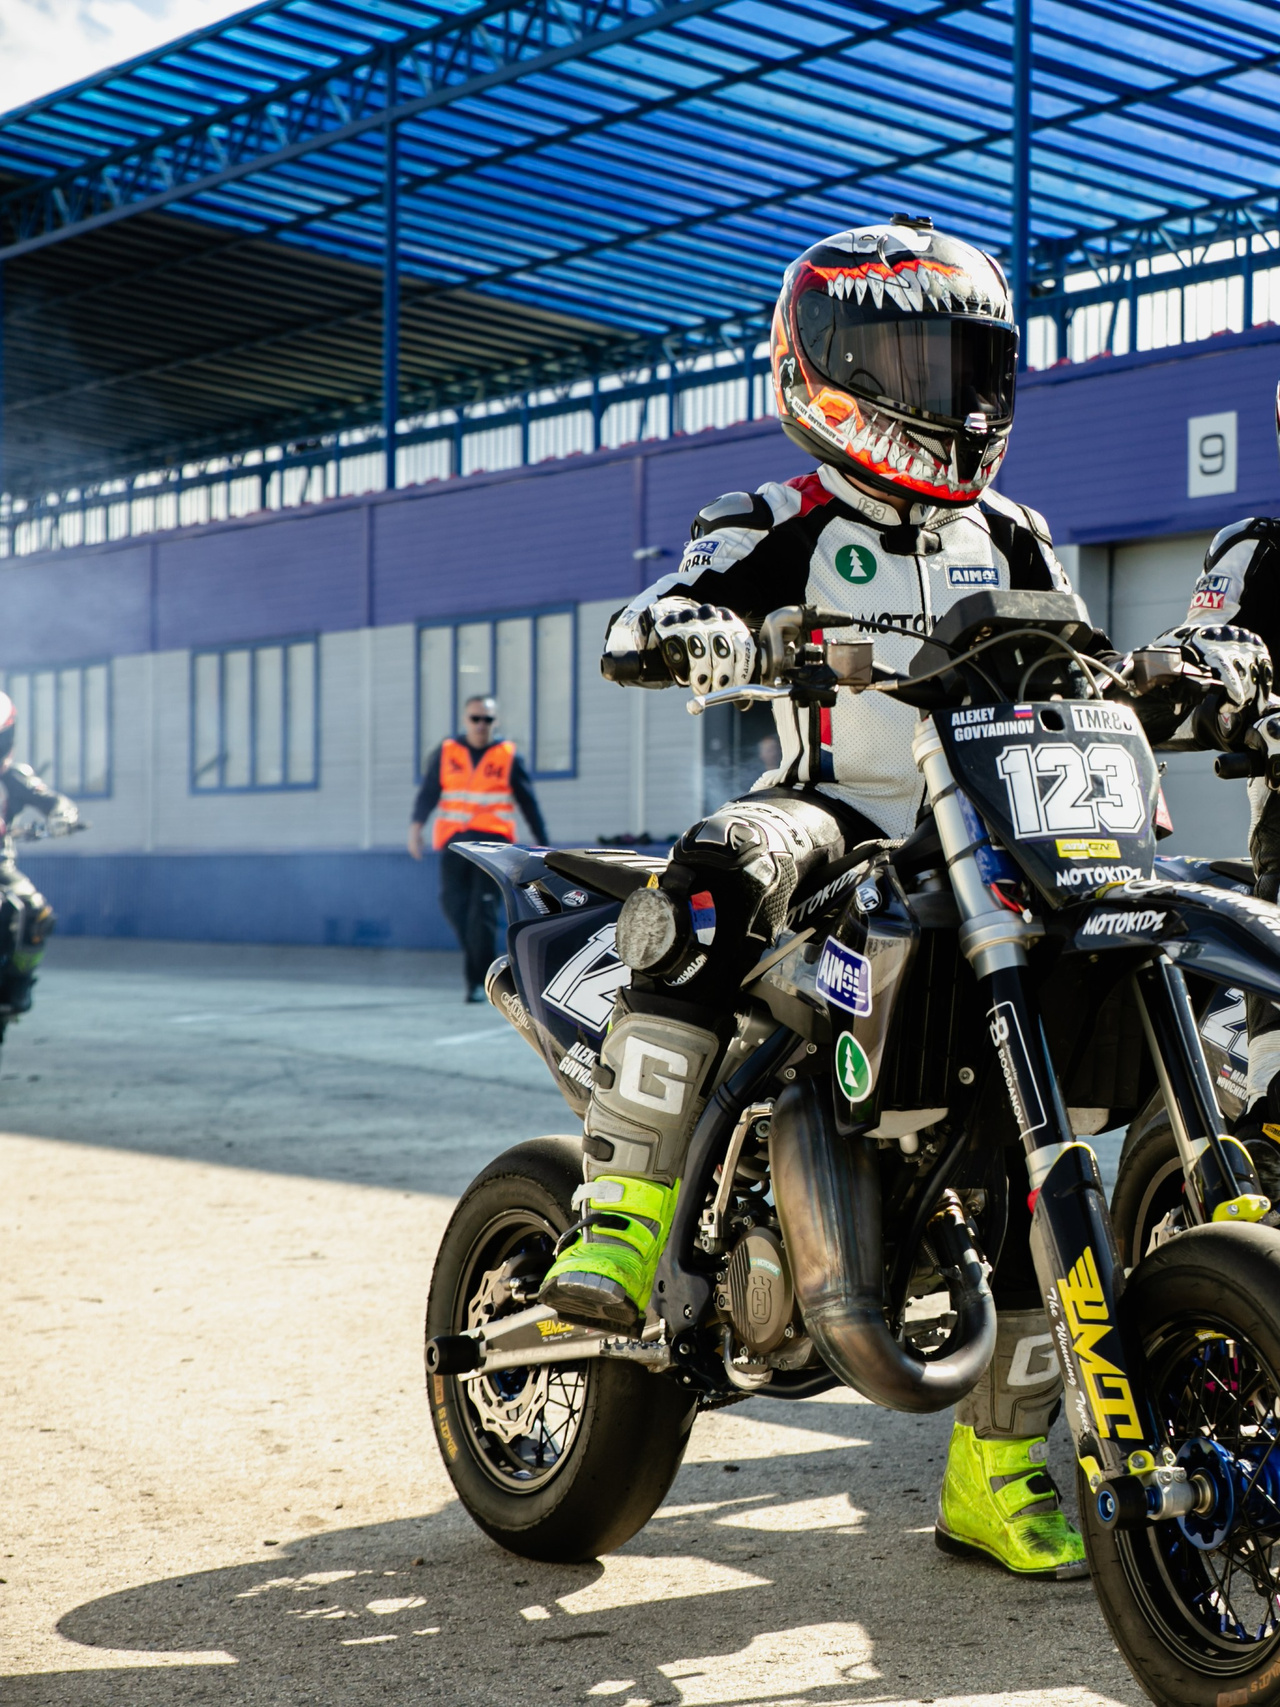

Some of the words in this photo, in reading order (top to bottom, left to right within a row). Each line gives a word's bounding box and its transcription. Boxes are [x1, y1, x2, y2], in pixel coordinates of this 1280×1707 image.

[1199, 433, 1225, 475] 9
[857, 497, 886, 520] 123
[951, 570, 998, 583] AIMOL
[952, 706, 996, 727] ALEXEY
[954, 719, 1035, 743] GOVYADINOV
[995, 742, 1147, 840] 123
[1056, 866, 1145, 888] MOTOKIDZ
[1082, 910, 1167, 936] MOTOKIDZ
[819, 950, 867, 1003] AIMOL
[619, 1035, 688, 1115] G
[998, 1048, 1024, 1124] BOGDANOV
[1047, 1287, 1059, 1318] The
[1055, 1321, 1077, 1387] Winning
[1075, 1390, 1091, 1434] Tyres
